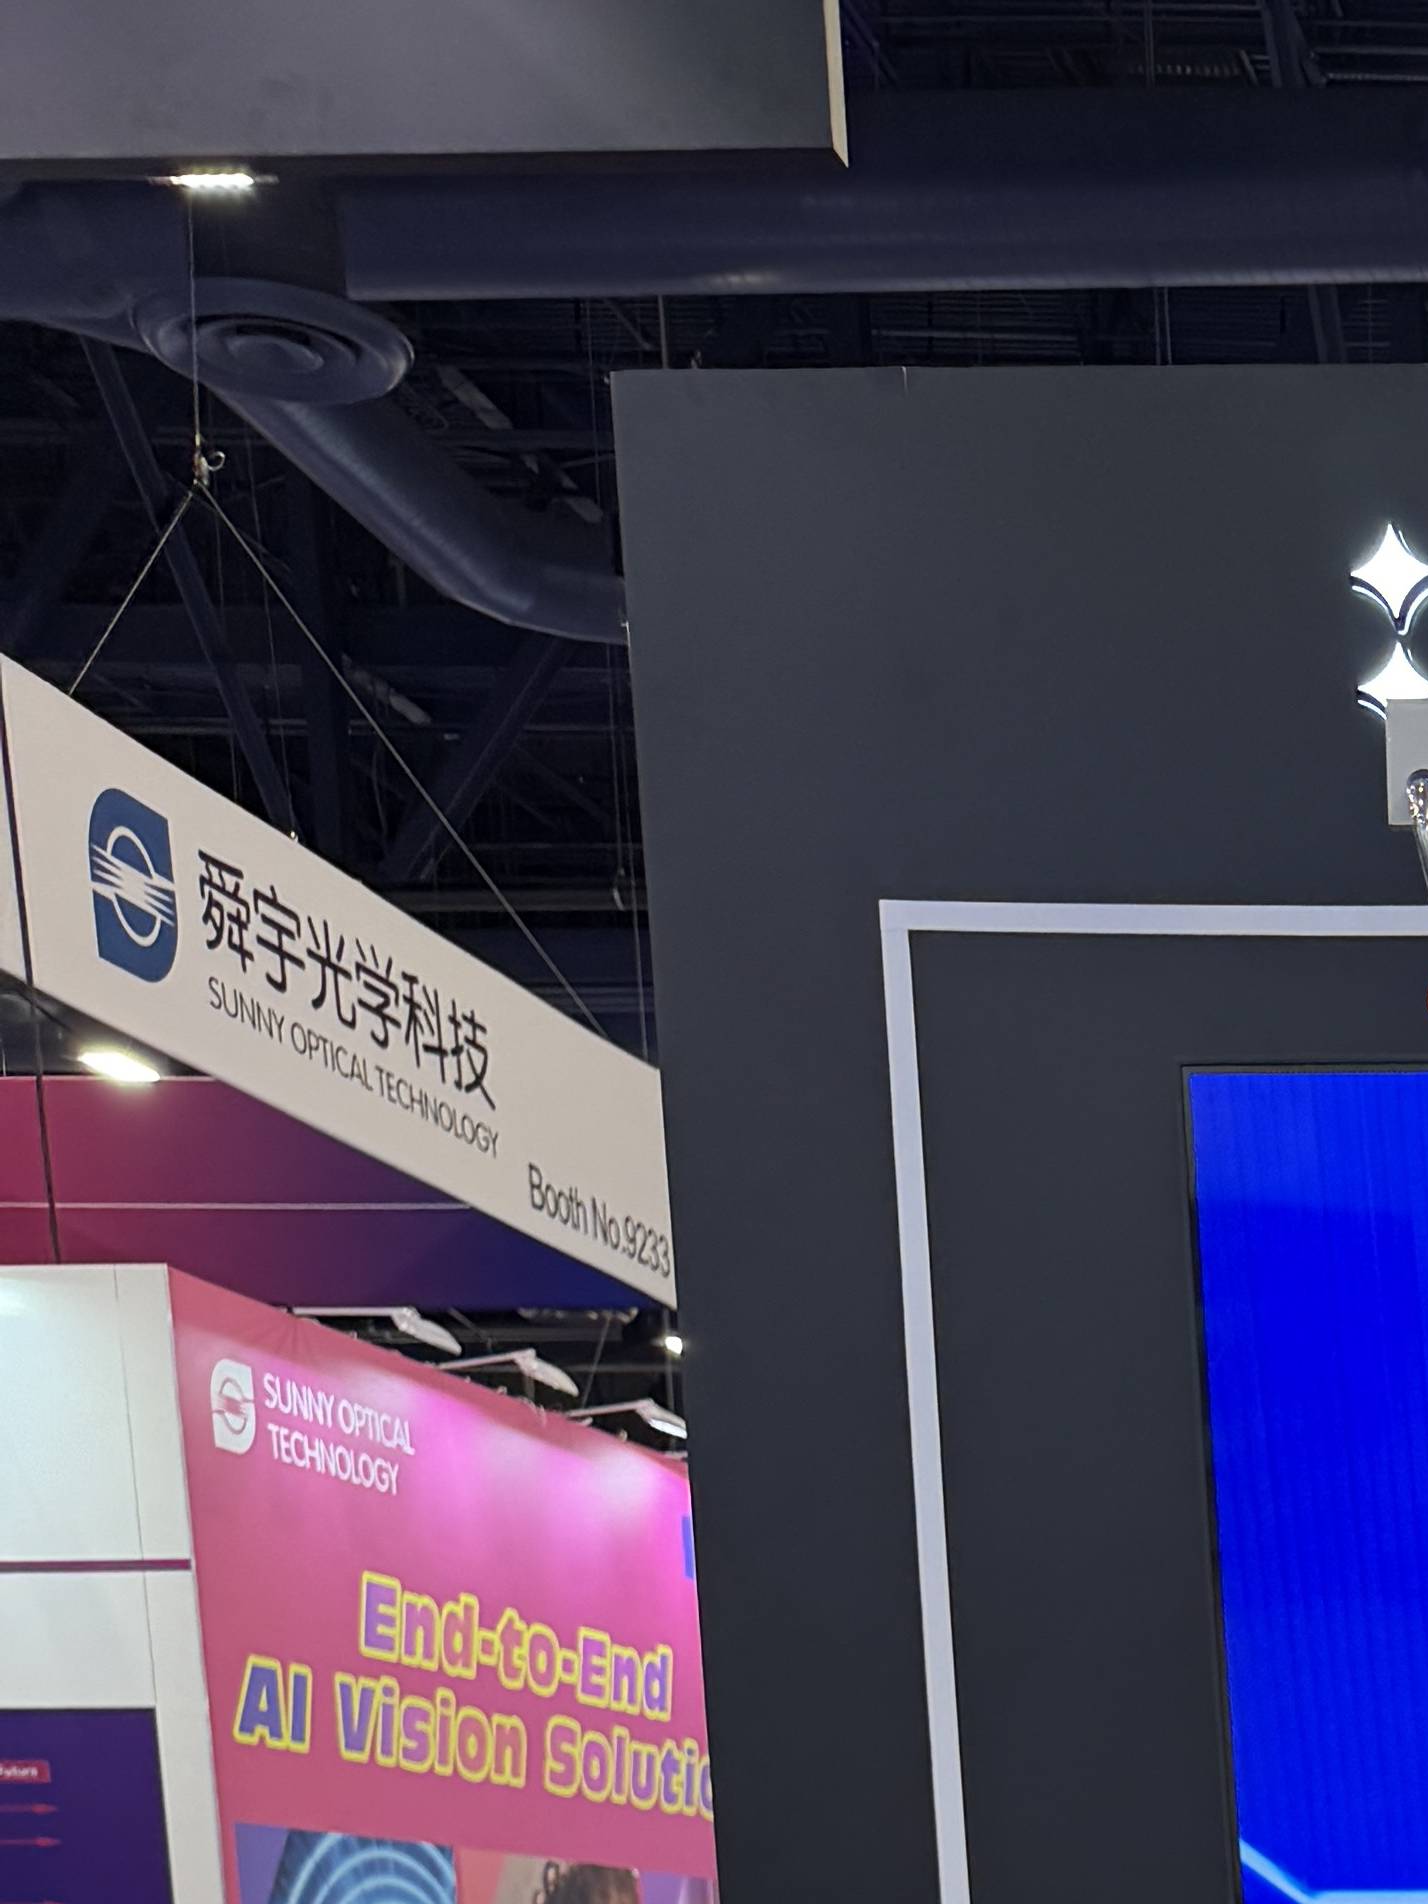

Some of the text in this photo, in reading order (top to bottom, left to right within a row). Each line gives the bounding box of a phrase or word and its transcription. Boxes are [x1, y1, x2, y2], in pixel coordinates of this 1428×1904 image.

[198, 848, 496, 1110] 舜宇光学科技
[208, 976, 499, 1159] SUNNY OPTICAL TECHNOLOGY
[529, 1162, 671, 1278] Booth No.9233
[263, 1372, 416, 1456] SUNNY OPTICAL
[267, 1423, 399, 1496] TECHNOLOGY
[358, 1570, 674, 1722] End-to-End
[235, 1655, 312, 1752] AI
[334, 1672, 528, 1789] Vision
